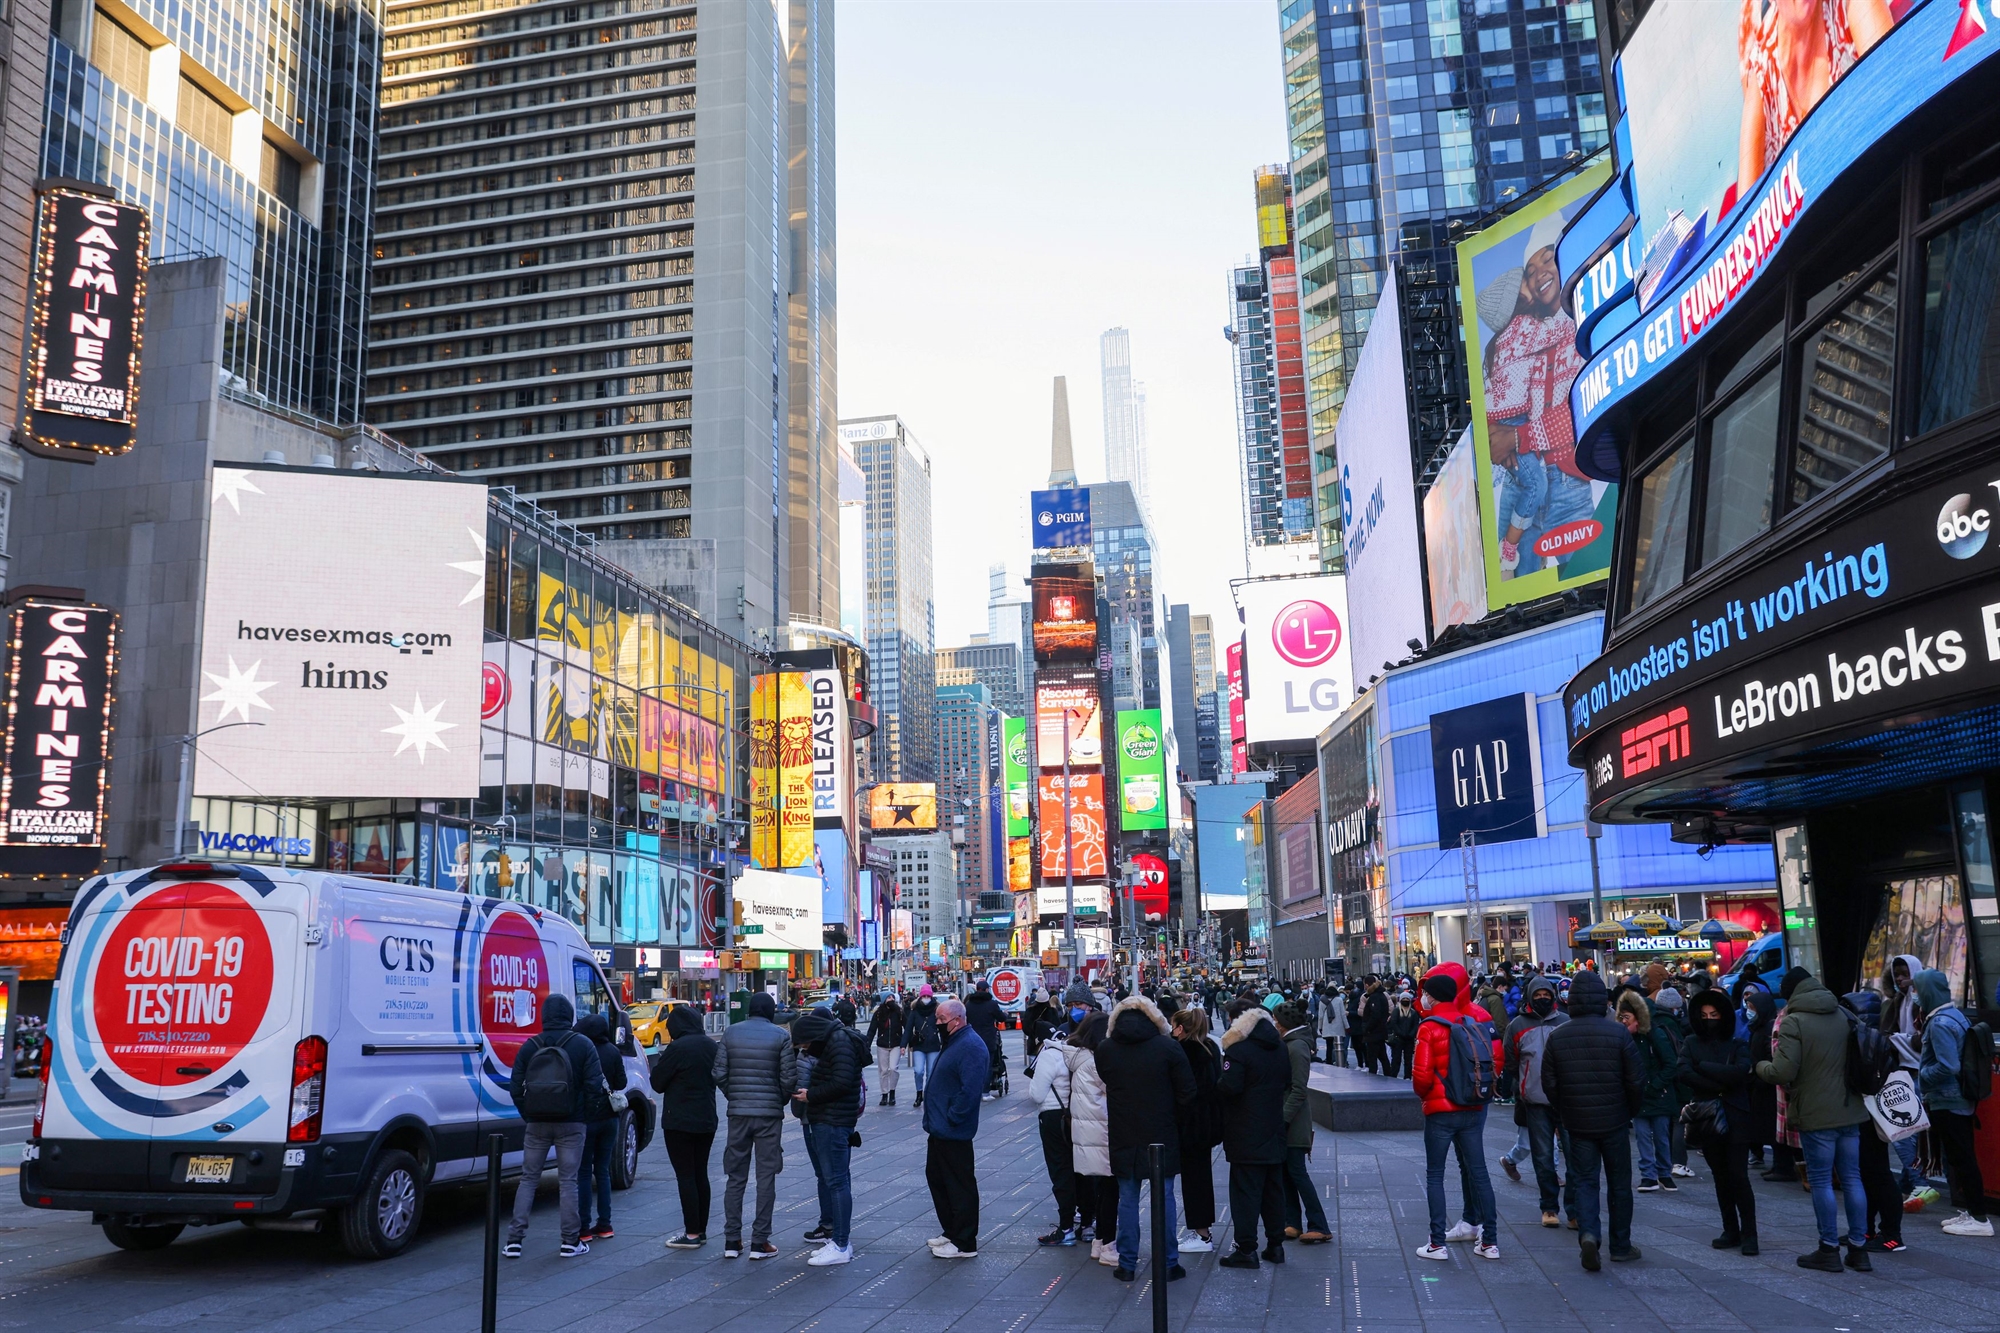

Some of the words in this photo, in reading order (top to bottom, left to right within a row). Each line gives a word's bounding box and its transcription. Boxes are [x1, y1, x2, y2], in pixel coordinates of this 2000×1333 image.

[1580, 361, 1611, 417] TIME
[1613, 338, 1639, 386] TO
[1643, 306, 1674, 364] GET
[1679, 150, 1804, 345] FUNDERSTRUCK
[1589, 249, 1618, 311] TO
[68, 203, 119, 383] CARMINES
[45, 383, 124, 406] ITALIAN
[46, 378, 88, 391] FAMILY
[91, 386, 124, 397] STYLE
[45, 393, 123, 411] RESTAURANT
[60, 403, 86, 413] NOW
[87, 407, 110, 418] OPEN
[1365, 477, 1385, 538] NOW.
[1056, 512, 1084, 523] PGIM
[1937, 508, 1991, 544] abc
[1540, 535, 1563, 553] OLD
[1563, 524, 1595, 547] NAVY
[1590, 680, 1608, 714] on
[1608, 635, 1689, 703] boosters
[1691, 599, 1748, 660] isn't
[1749, 541, 1890, 633] working
[301, 660, 389, 690] hims
[1039, 687, 1088, 698] Discover
[1284, 678, 1340, 713] LG
[35, 611, 88, 807] CARMINES
[1039, 697, 1094, 710] Samsung
[1621, 705, 1691, 779] ESPN
[1714, 671, 1822, 740] LeBron
[1828, 626, 1968, 703] backs
[813, 677, 836, 811] RELEASED
[1127, 741, 1155, 750] Green
[1130, 749, 1157, 757] Giant
[1452, 739, 1509, 808] GAP
[788, 784, 804, 792] THE
[785, 796, 807, 809] LION
[10, 815, 94, 828] ITALIAN
[12, 808, 56, 818] FAMILY
[57, 809, 94, 819] STYLE
[783, 811, 810, 826] KING
[10, 824, 94, 834] RESTAURANT
[1328, 820, 1344, 856] OLD
[1344, 806, 1367, 850] NAVY
[27, 834, 53, 843] NOW
[53, 834, 78, 844] OPEN
[419, 833, 430, 879] NEWS
[1357, 918, 1366, 933] NAVY
[1618, 936, 1676, 950] CHICKEN
[124, 936, 245, 979] COVID-19
[379, 935, 435, 973] CTS
[490, 953, 538, 989] COVID-19
[385, 975, 406, 986] MOBILE
[407, 976, 429, 987] TESTING
[124, 983, 234, 1025] TESTING
[113, 1045, 228, 1055] WWW.CTSMOBILETESTING.COM
[1882, 1086, 1906, 1099] crazy
[1883, 1093, 1911, 1108] donkey
[189, 1162, 206, 1176] XKL
[211, 1162, 231, 1176] G57
